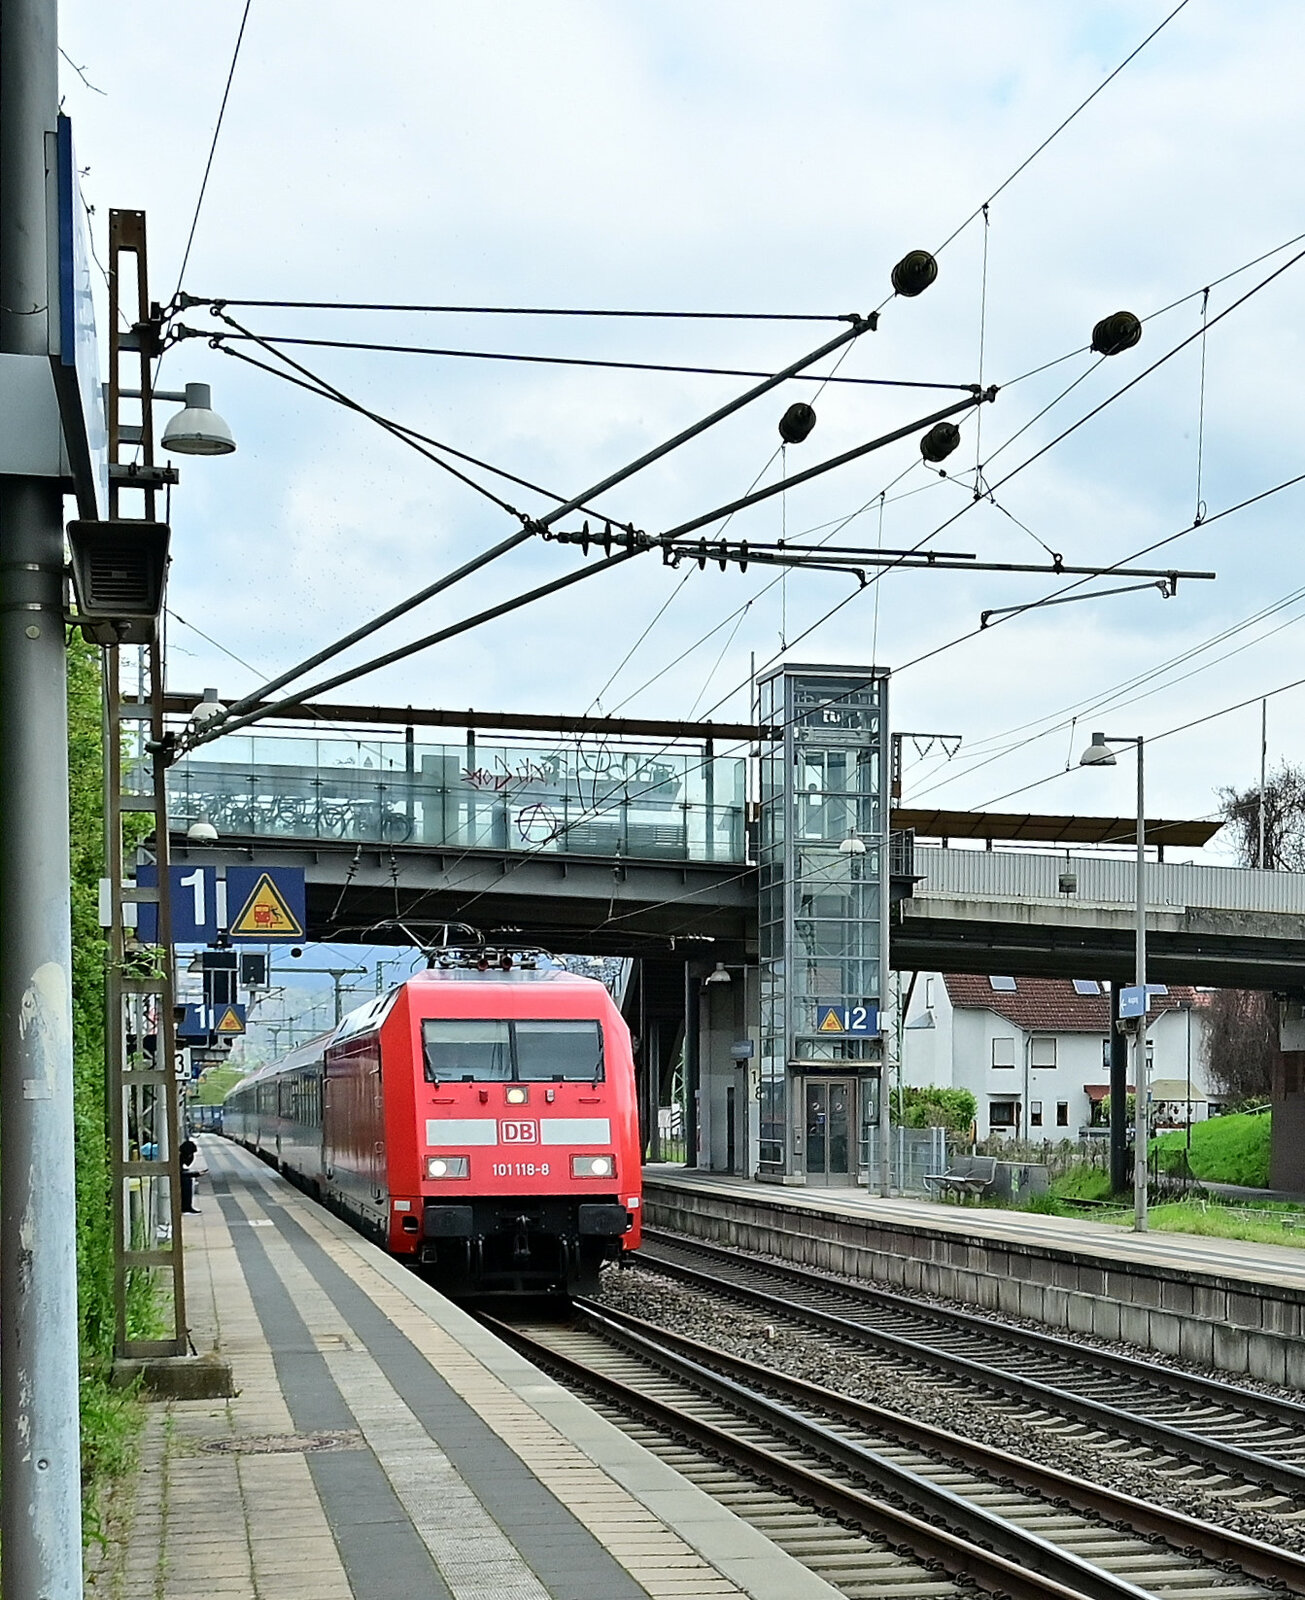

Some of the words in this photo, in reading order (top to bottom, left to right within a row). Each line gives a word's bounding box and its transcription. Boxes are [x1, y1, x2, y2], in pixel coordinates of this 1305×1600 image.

[179, 868, 206, 926] 1
[194, 1004, 207, 1029] 1
[852, 1006, 867, 1030] 2
[504, 1123, 534, 1141] DB
[492, 1163, 512, 1176] 101
[515, 1163, 550, 1176] 118-8
